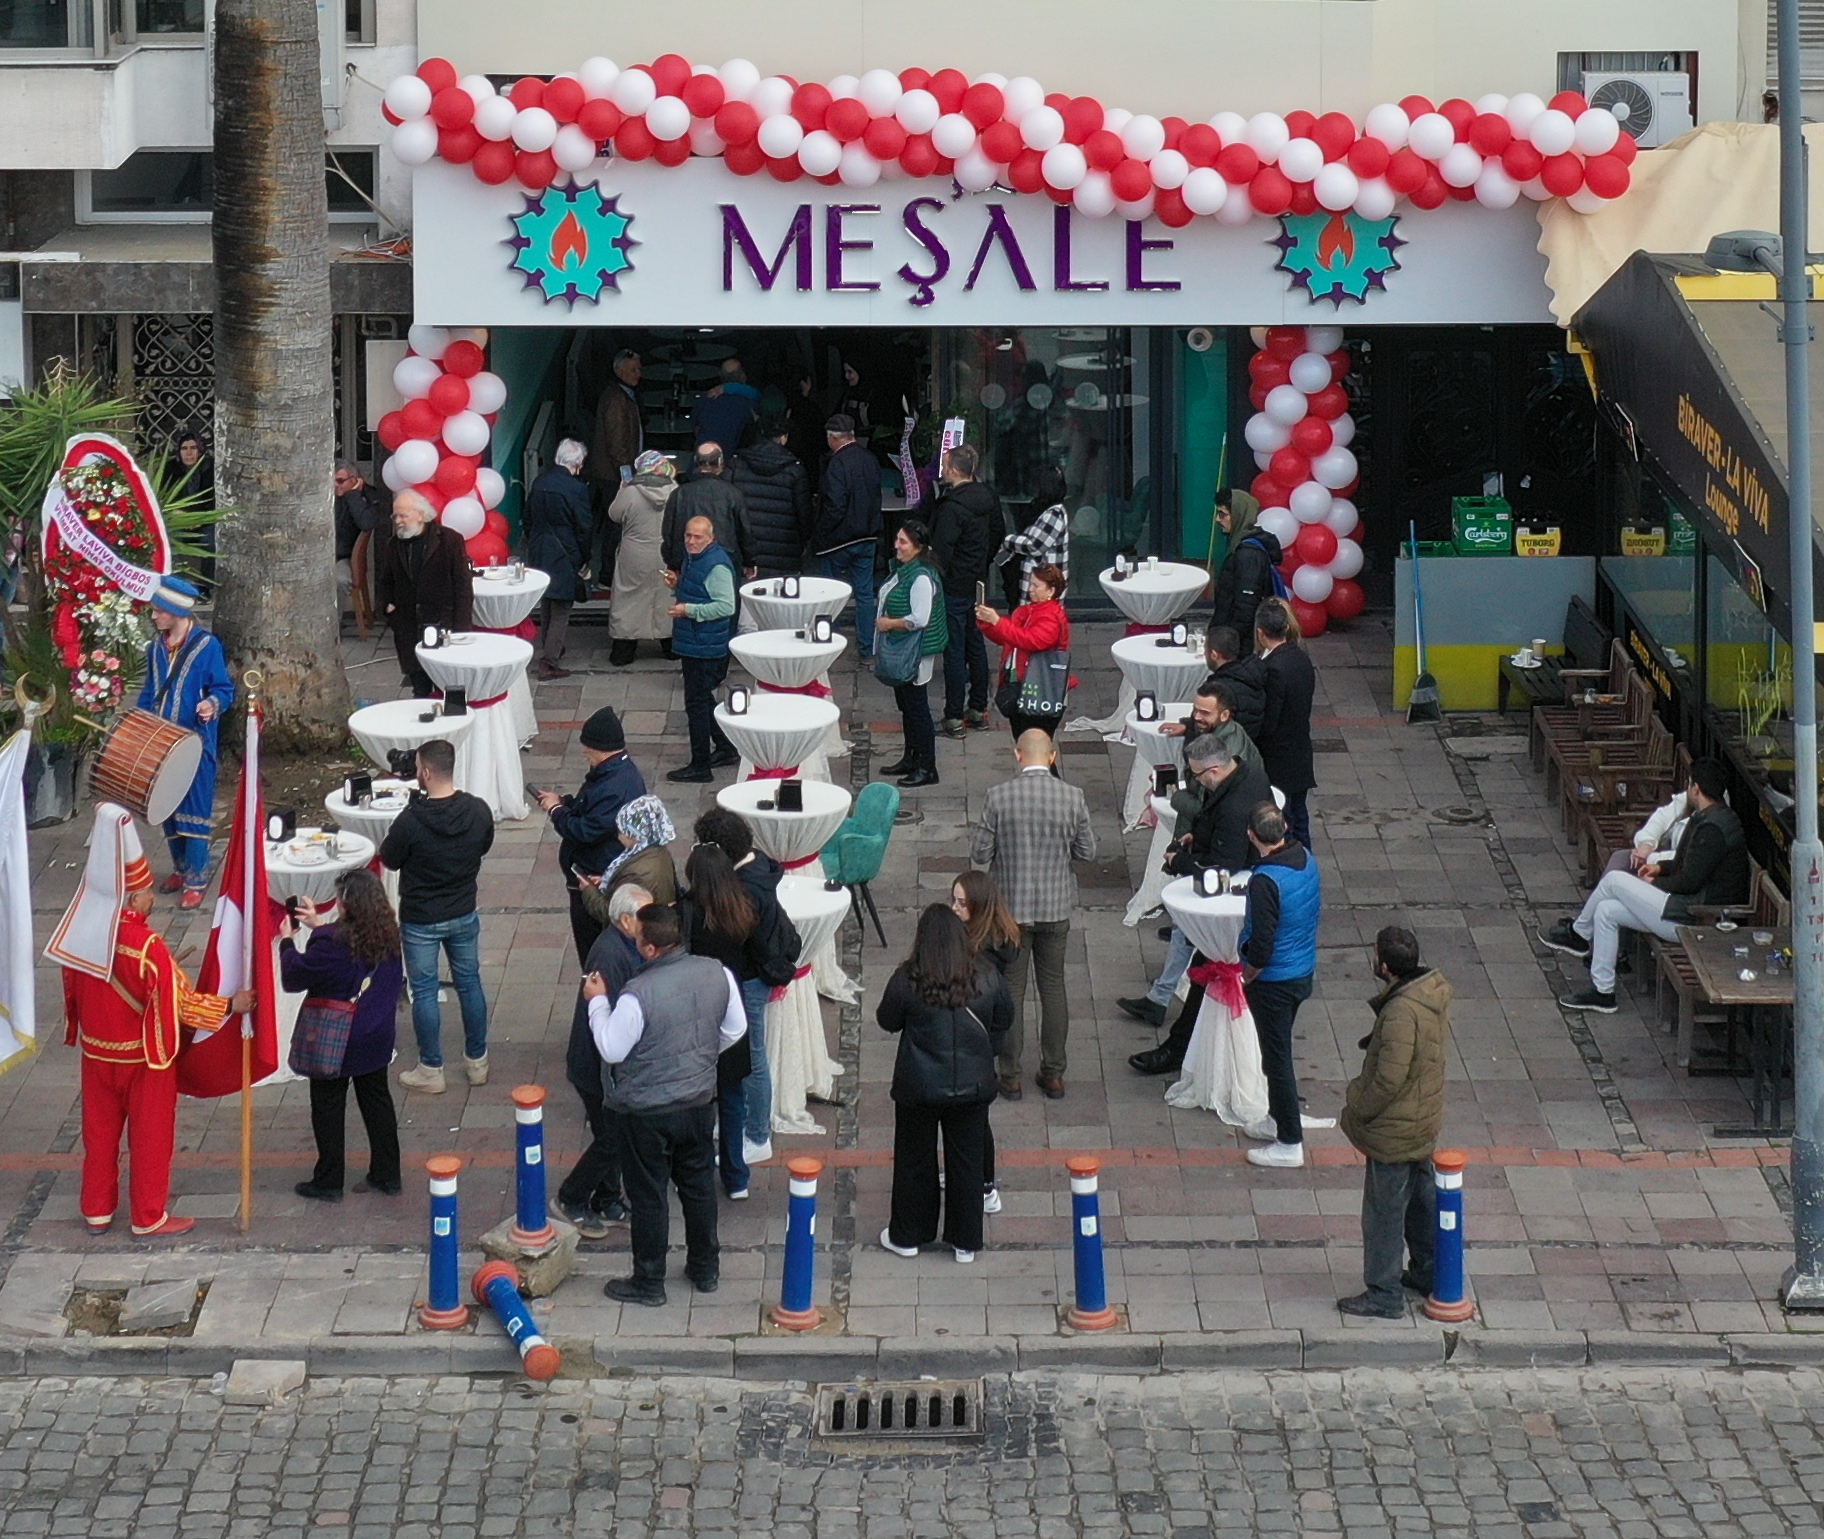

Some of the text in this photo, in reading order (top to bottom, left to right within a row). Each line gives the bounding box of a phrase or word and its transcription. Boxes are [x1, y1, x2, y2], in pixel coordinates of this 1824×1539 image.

[717, 195, 1183, 308] MEŞALE
[1678, 392, 1722, 474] BİRAVER
[1726, 445, 1741, 498] LA
[1743, 466, 1770, 536] VİVA
[1705, 471, 1740, 536] Lounge
[82, 534, 115, 565] LAVİVA
[1464, 526, 1508, 543] Carlsberg
[1520, 537, 1556, 548] TUBORG
